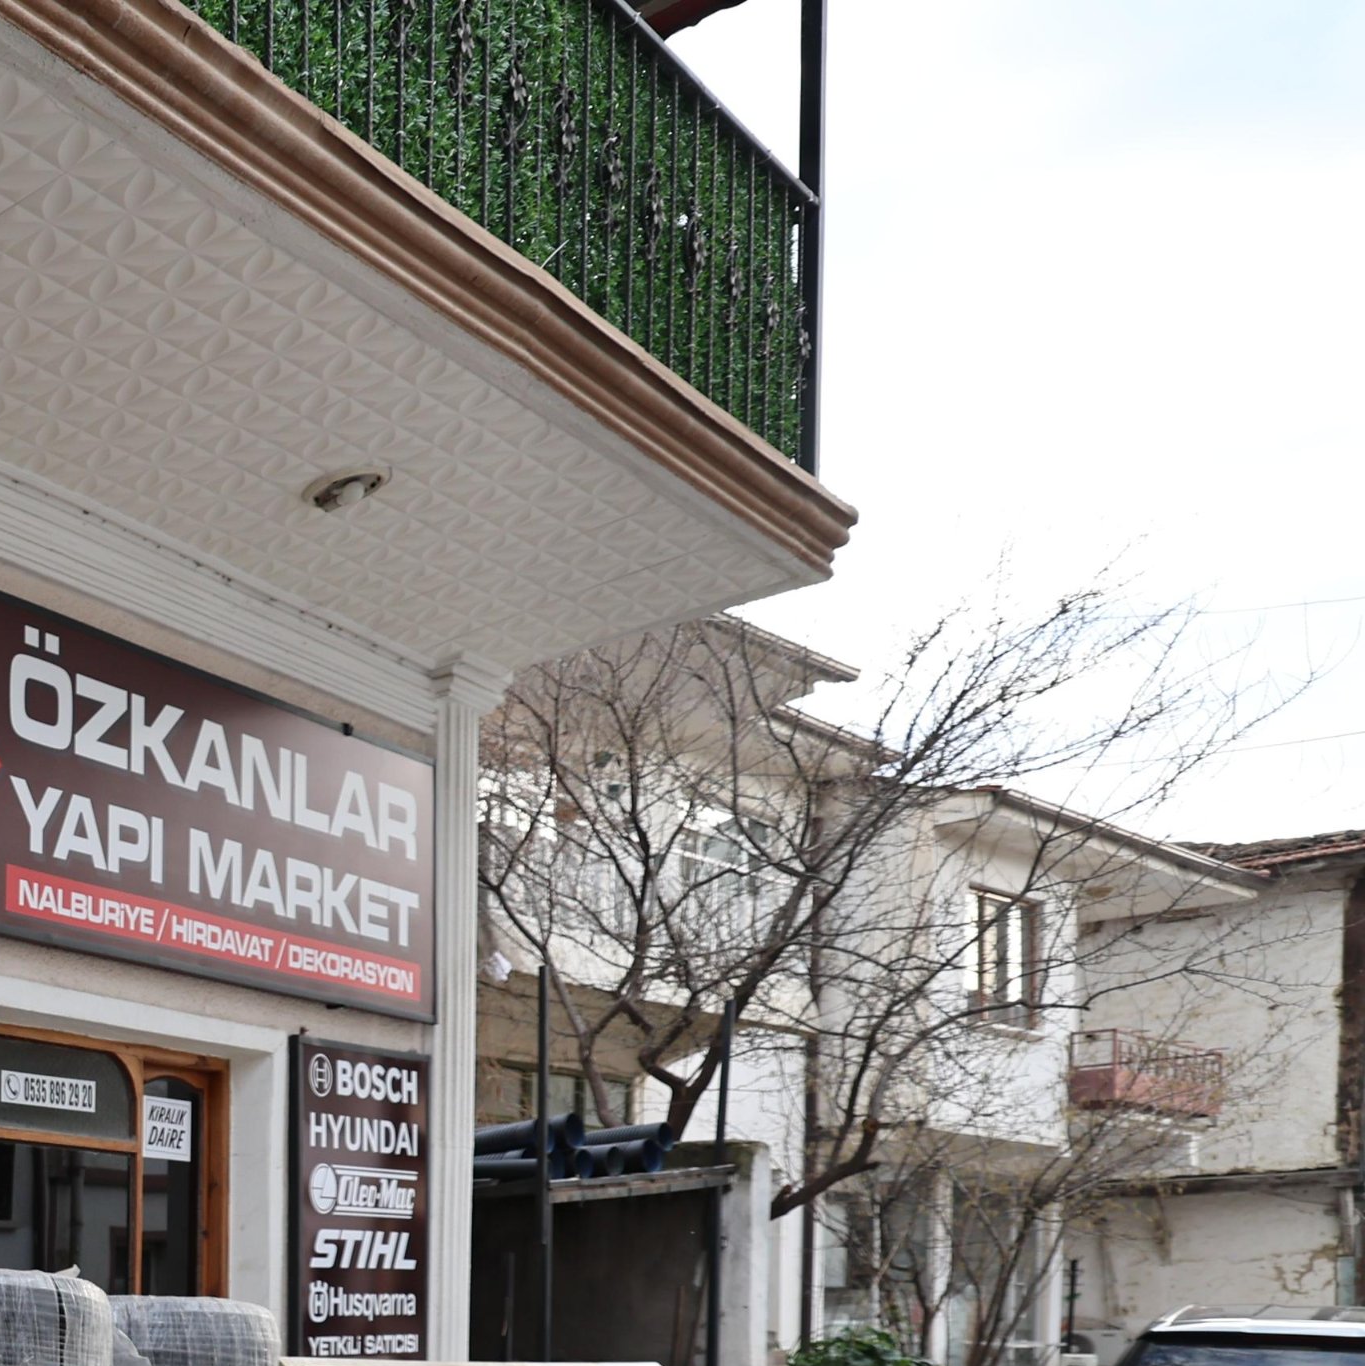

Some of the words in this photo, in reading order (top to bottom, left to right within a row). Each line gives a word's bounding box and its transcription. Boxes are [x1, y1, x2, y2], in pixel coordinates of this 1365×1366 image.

[9, 624, 418, 861] ÖZKANLAR
[8, 774, 164, 885] YAPI
[188, 828, 419, 947] MARKET
[24, 1077, 47, 1102] 0535
[49, 1079, 66, 1106] 896
[69, 1083, 80, 1107] 29
[82, 1085, 93, 1109] 20
[336, 1059, 418, 1105] BOSCH
[309, 1111, 418, 1157] HYUNDAI
[337, 1175, 416, 1211] Oleo-Mac
[309, 1228, 417, 1271] STIHL
[329, 1286, 417, 1322] Husqvarna
[364, 1333, 419, 1355] SATICISI
